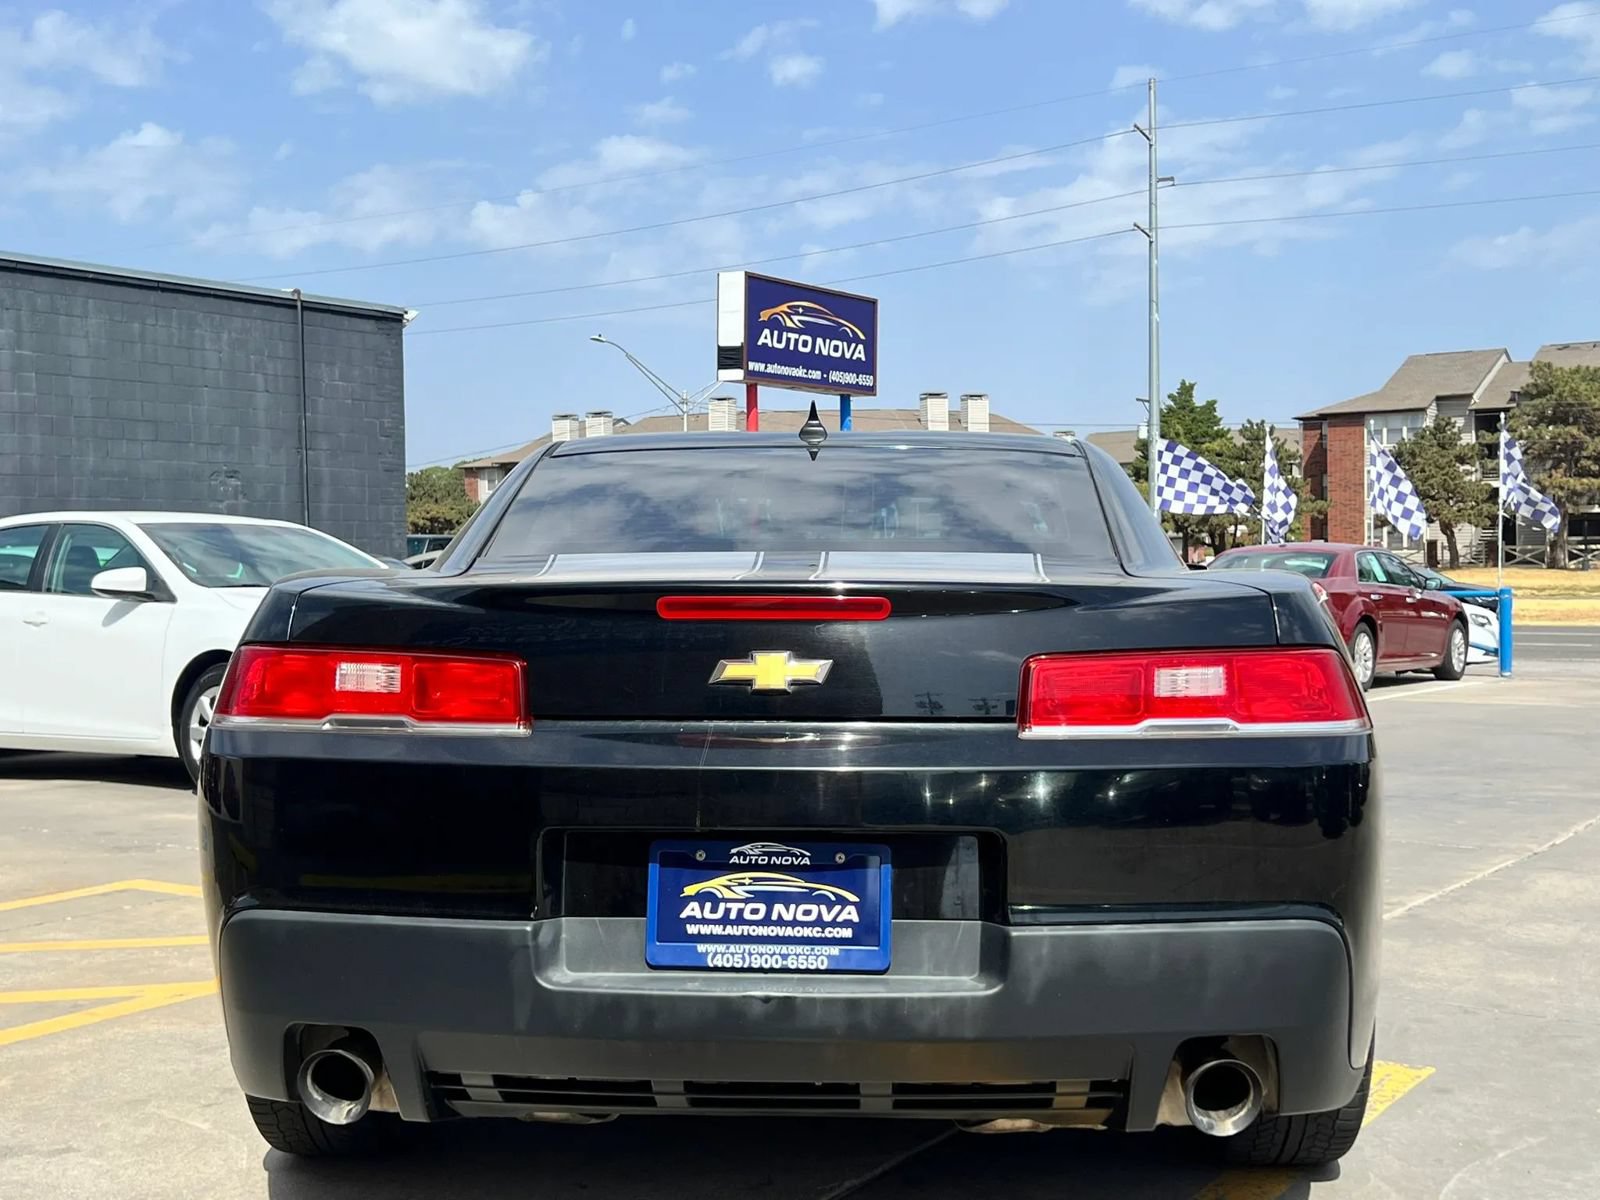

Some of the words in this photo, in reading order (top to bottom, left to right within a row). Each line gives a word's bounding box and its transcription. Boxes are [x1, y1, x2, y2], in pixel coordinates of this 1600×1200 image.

[757, 328, 812, 353] AUTO
[815, 337, 866, 362] NOVA
[748, 360, 822, 380] www.autonovaokc.com
[829, 370, 874, 387] (405)900-6550
[729, 855, 768, 865] AUTO
[770, 855, 811, 866] NOVA
[680, 901, 766, 922] AUTO
[771, 903, 860, 923] NOVA
[686, 924, 853, 939] WWW.AUTONOVAOKC.COM
[697, 944, 840, 956] WWW.AUTONOVAOKC.COM
[707, 953, 829, 970] (405)900-6550
